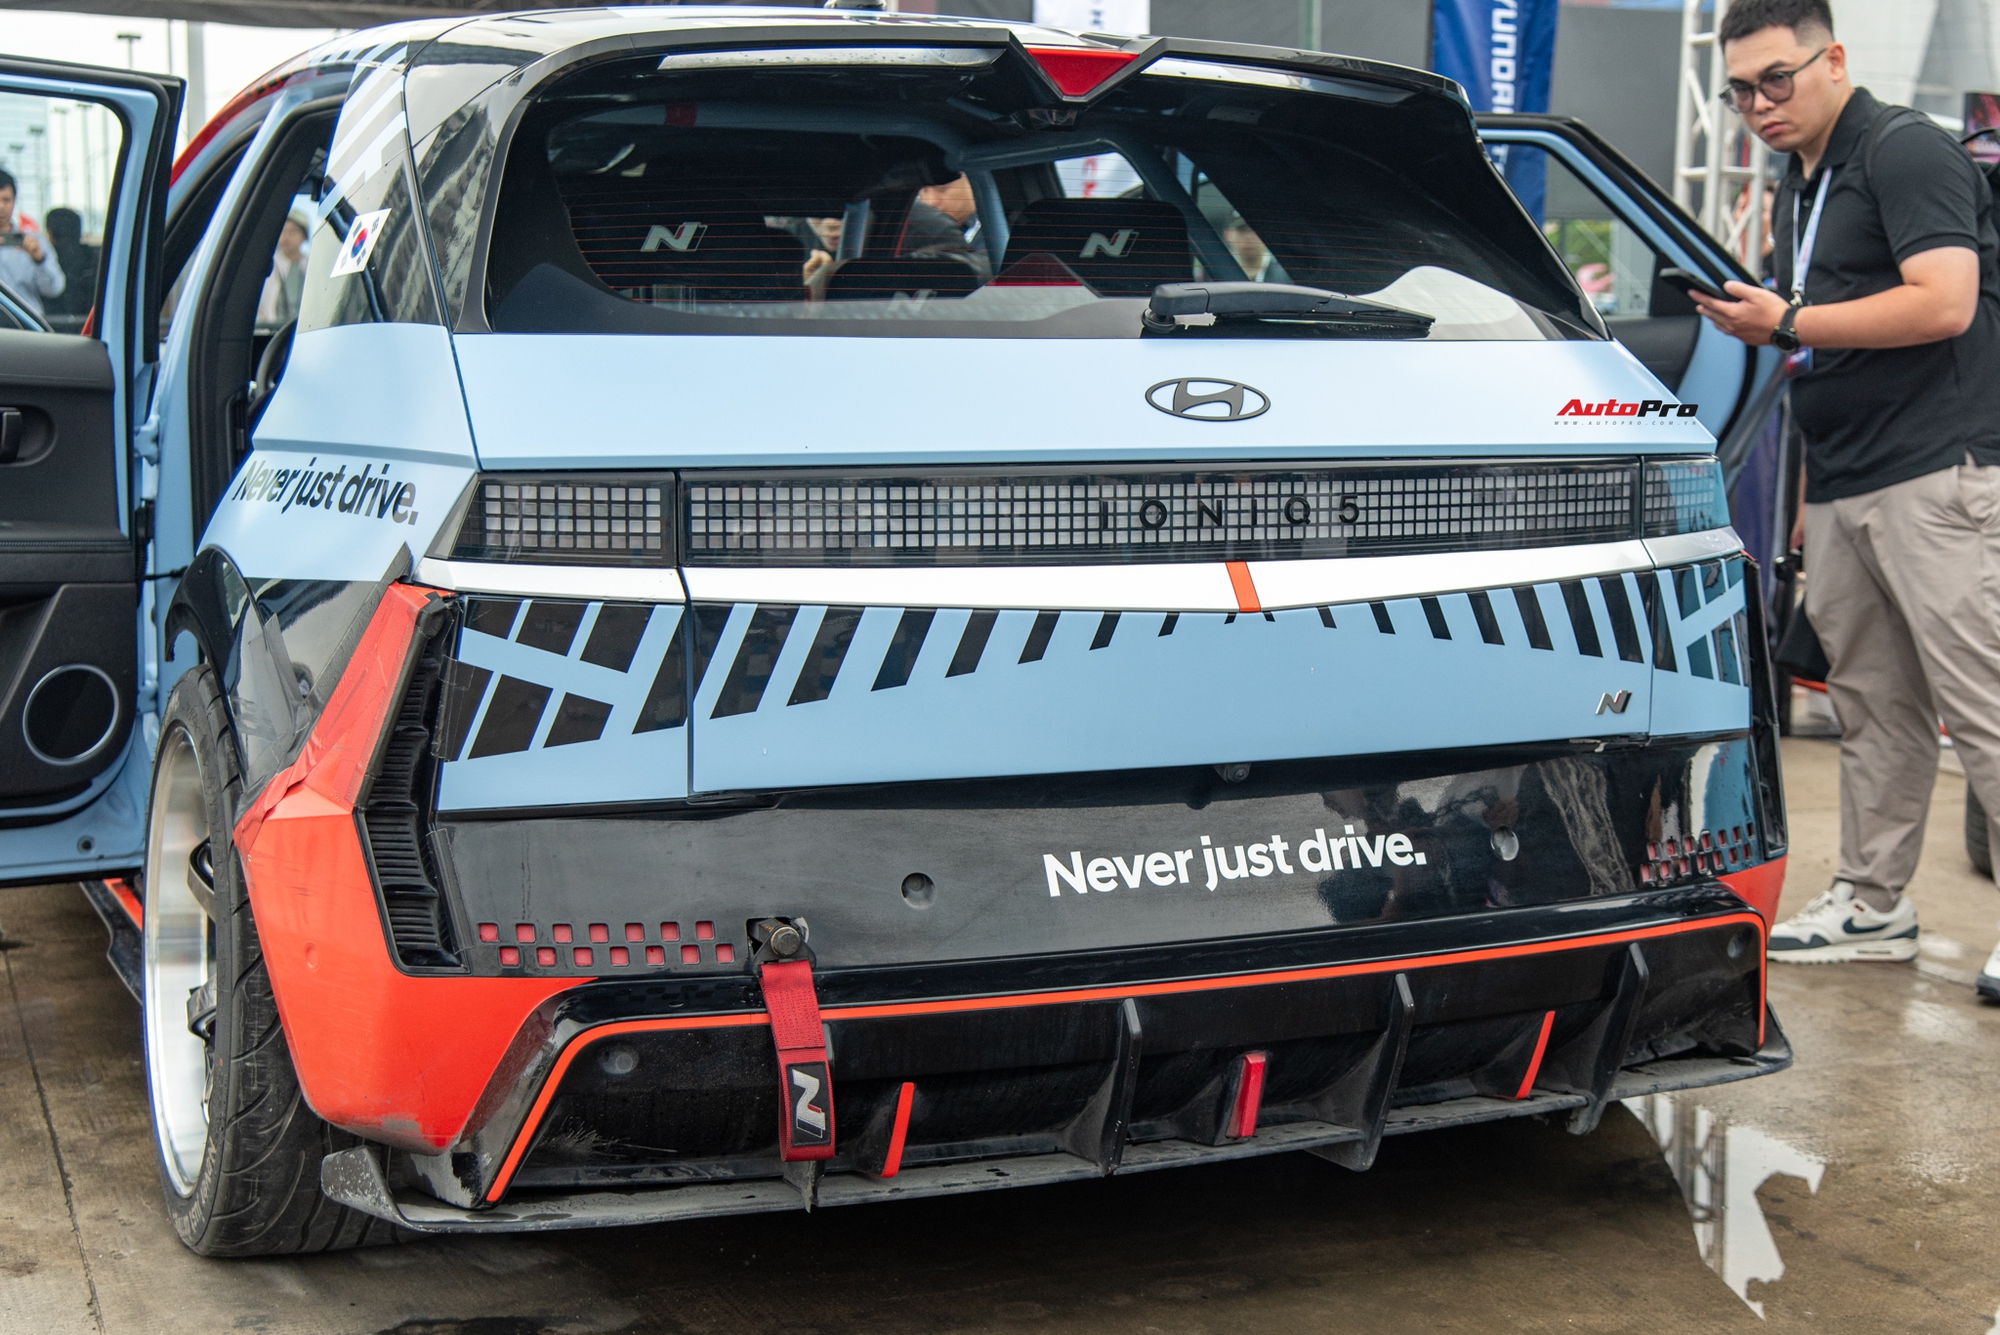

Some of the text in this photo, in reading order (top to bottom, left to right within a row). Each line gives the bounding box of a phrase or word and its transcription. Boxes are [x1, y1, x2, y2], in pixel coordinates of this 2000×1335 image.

[641, 222, 708, 252] N
[1079, 229, 1139, 258] N
[231, 457, 419, 526] Never just drive.
[1101, 493, 1360, 531] IONIQ 5
[1595, 689, 1633, 715] N
[1043, 824, 1428, 897] Never just drive.
